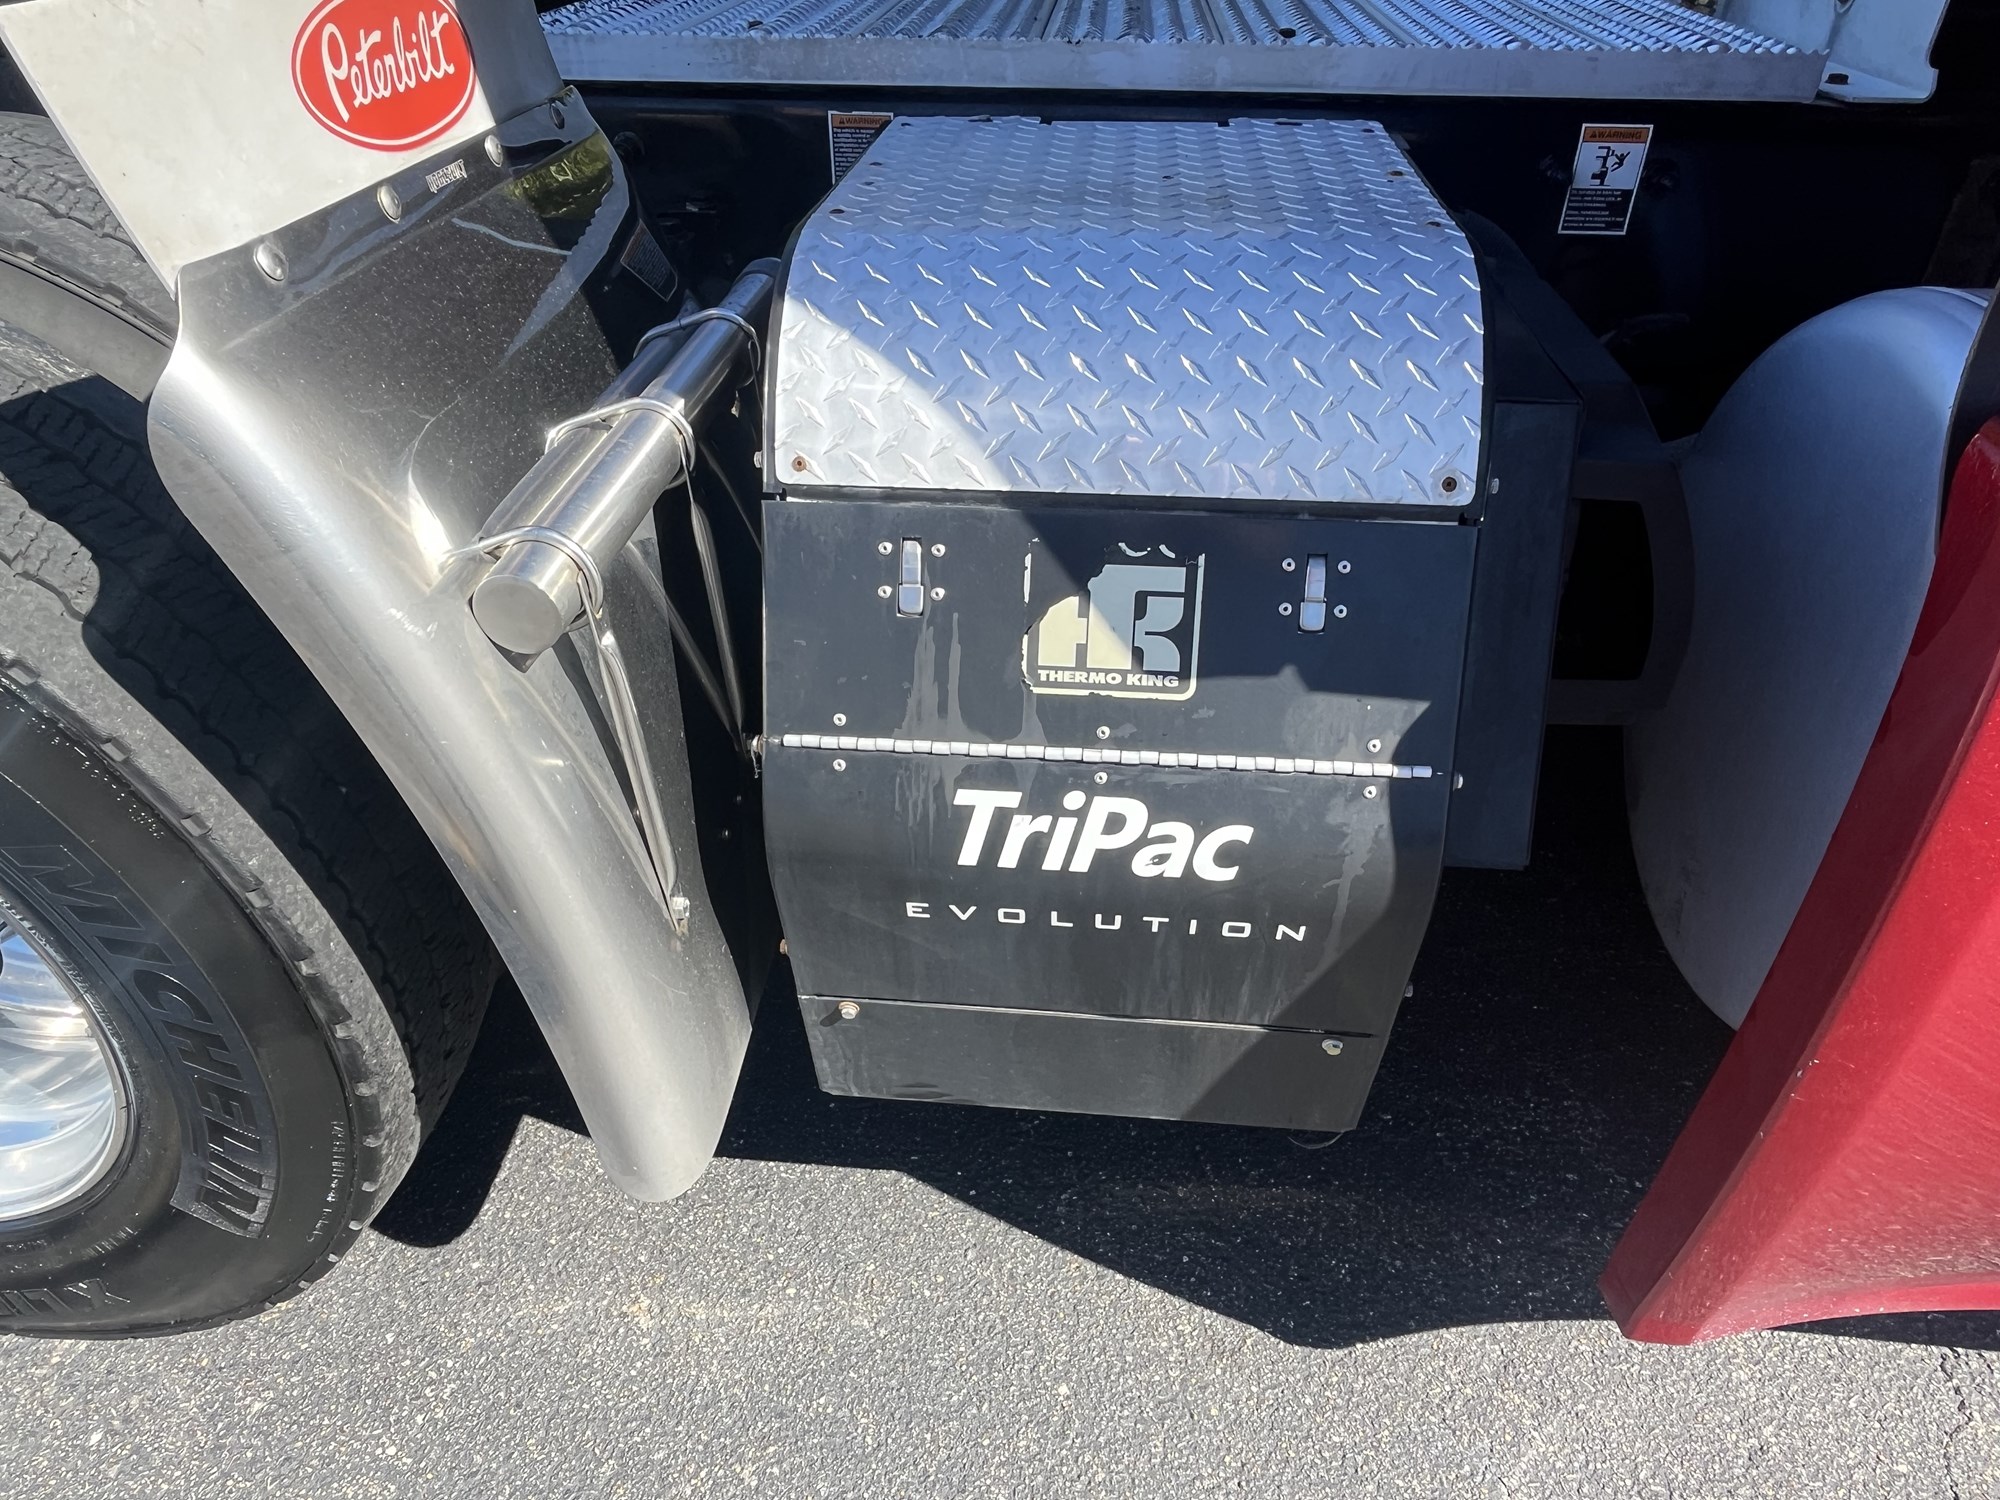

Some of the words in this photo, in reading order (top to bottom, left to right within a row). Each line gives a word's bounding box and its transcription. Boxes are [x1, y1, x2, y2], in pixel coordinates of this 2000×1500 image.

[321, 11, 454, 123] Peterbilt
[1597, 130, 1642, 140] WARNING
[1038, 669, 1123, 685] THERMO
[1126, 674, 1180, 688] KING
[953, 788, 1254, 881] TriPac
[905, 901, 1306, 941] EVOLUTION
[1, 844, 265, 1229] MICHELIN
